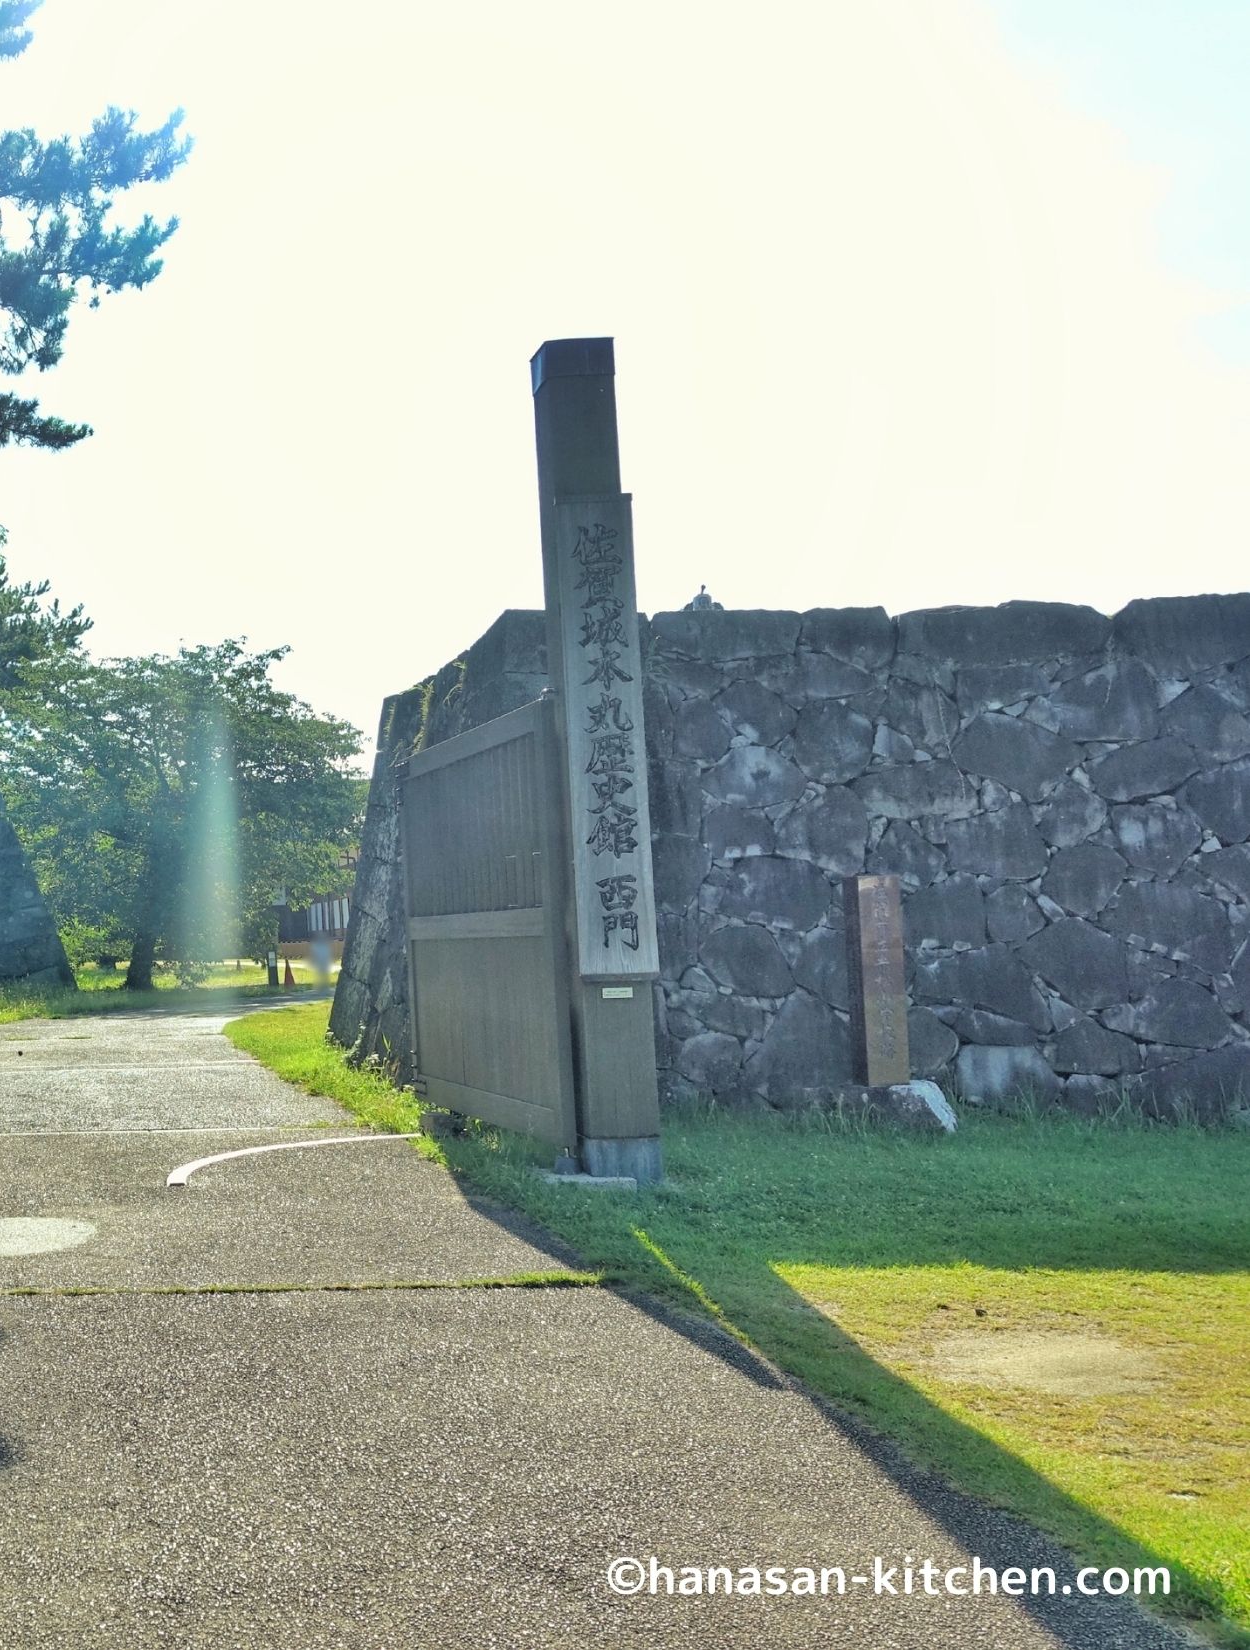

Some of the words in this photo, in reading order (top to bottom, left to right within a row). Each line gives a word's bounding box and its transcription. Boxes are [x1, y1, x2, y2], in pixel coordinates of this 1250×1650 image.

[571, 523, 638, 859] 佐賀城本丸歴史館
[596, 874, 639, 951] 西門
